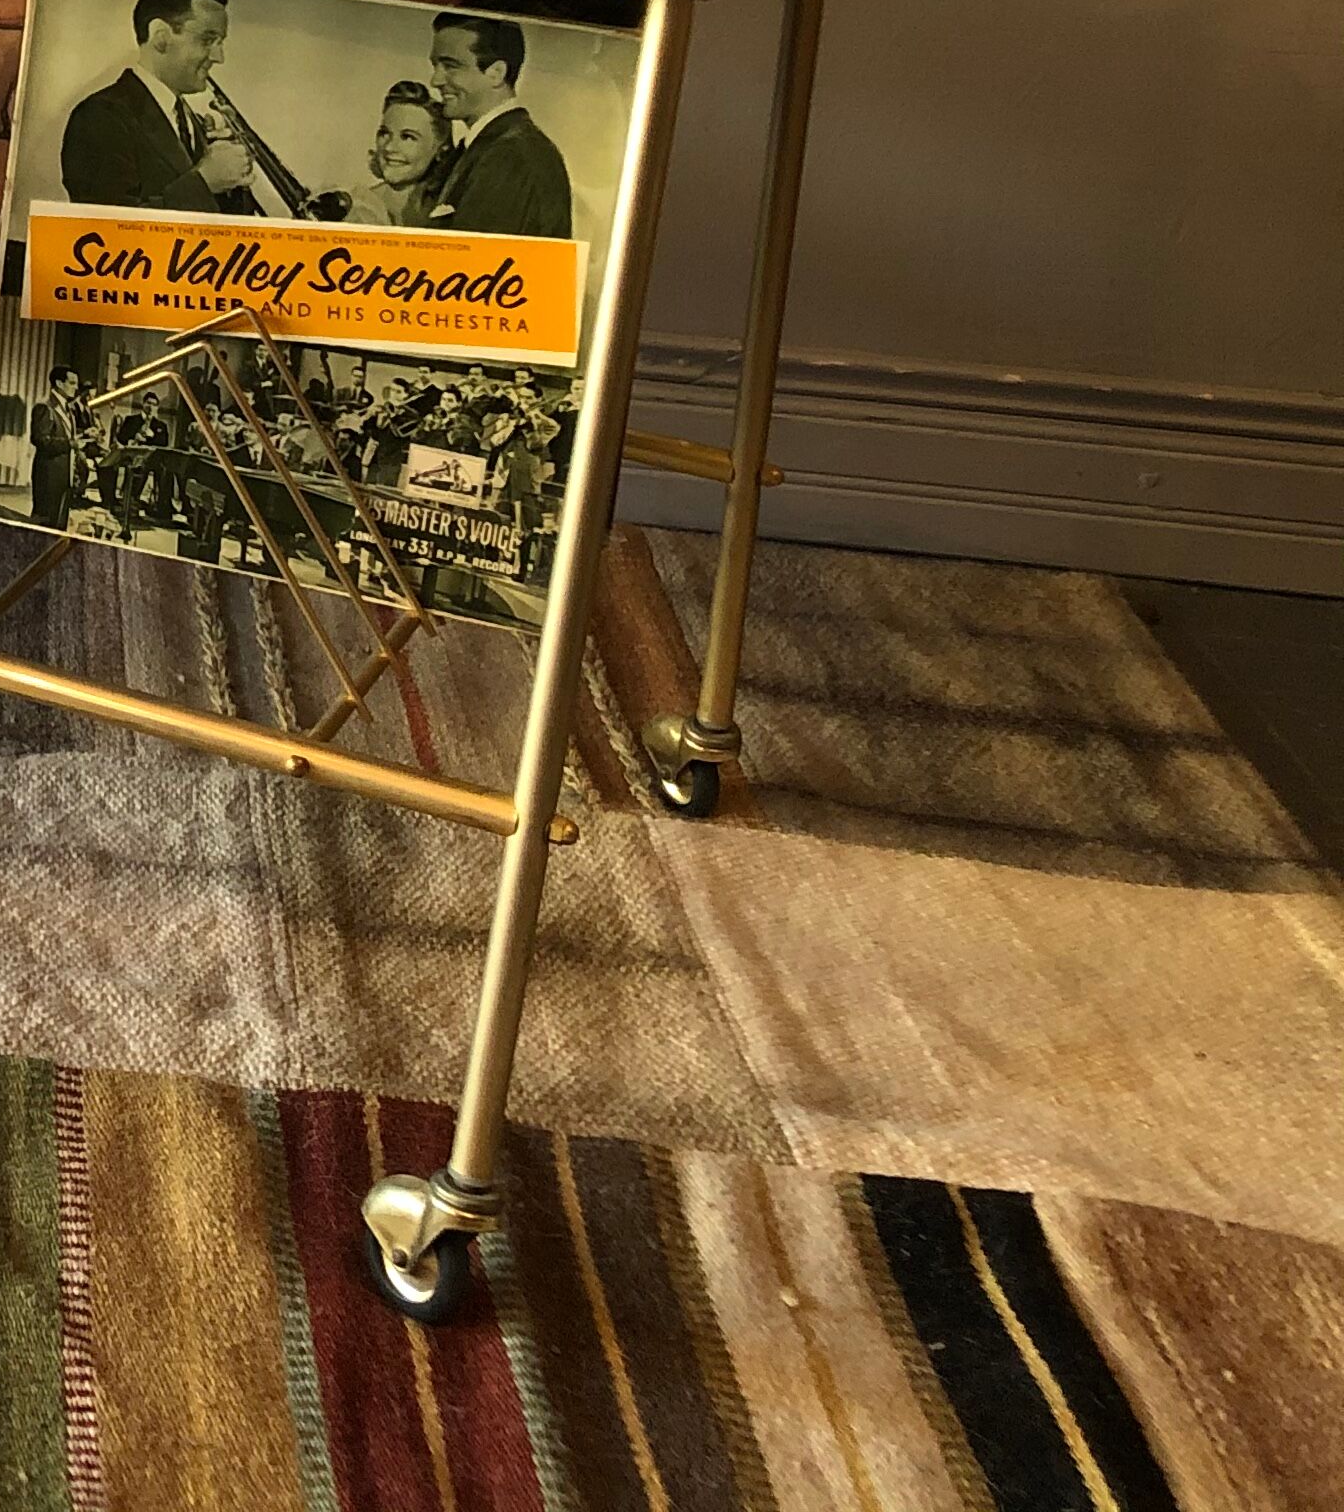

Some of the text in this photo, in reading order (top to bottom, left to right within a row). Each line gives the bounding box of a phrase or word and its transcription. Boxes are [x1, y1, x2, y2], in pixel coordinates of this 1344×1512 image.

[117, 223, 145, 232] MUSIC
[149, 225, 174, 234] FROM
[178, 227, 194, 236] THE
[199, 228, 231, 237] SOUND
[236, 230, 266, 239] TRACK
[270, 232, 284, 240] OF
[287, 233, 304, 242] THE
[332, 236, 376, 247] CENTURY
[405, 241, 472, 252] PRODUCTION
[64, 232, 528, 309] Sun Valley Serenade
[54, 287, 530, 334] GLENN MILLER AND HIS ORCHESTRA
[384, 500, 468, 541] MASTER'S
[470, 518, 521, 553] VOICE
